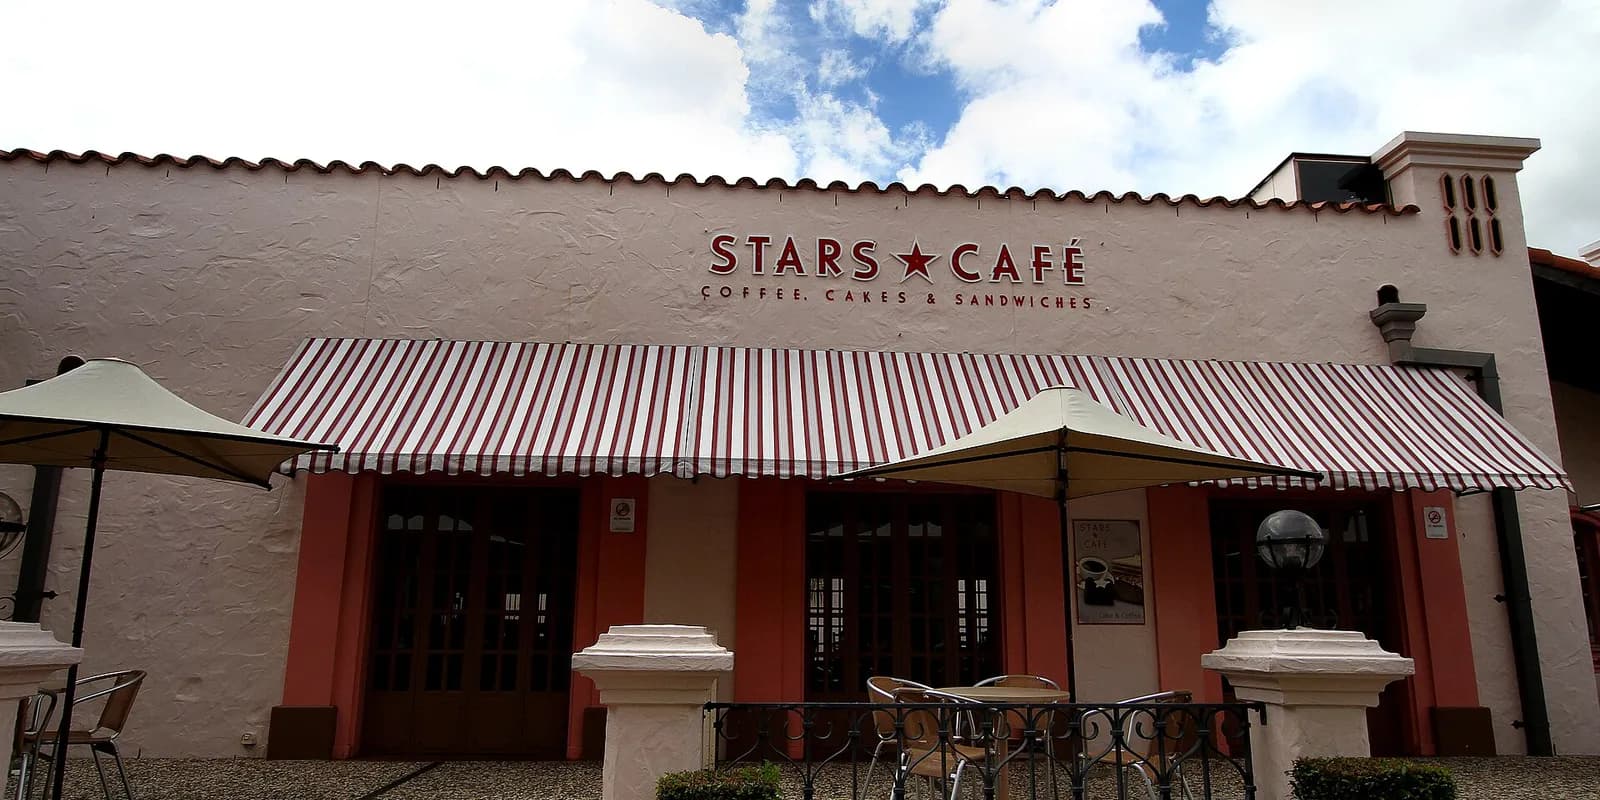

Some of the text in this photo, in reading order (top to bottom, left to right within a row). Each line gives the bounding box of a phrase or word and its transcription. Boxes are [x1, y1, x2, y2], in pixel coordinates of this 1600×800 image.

[708, 234, 1086, 285] STARS CAFÉ
[825, 289, 906, 303] CAKES
[926, 293, 936, 304] &
[955, 293, 1091, 309] SANDWICHES
